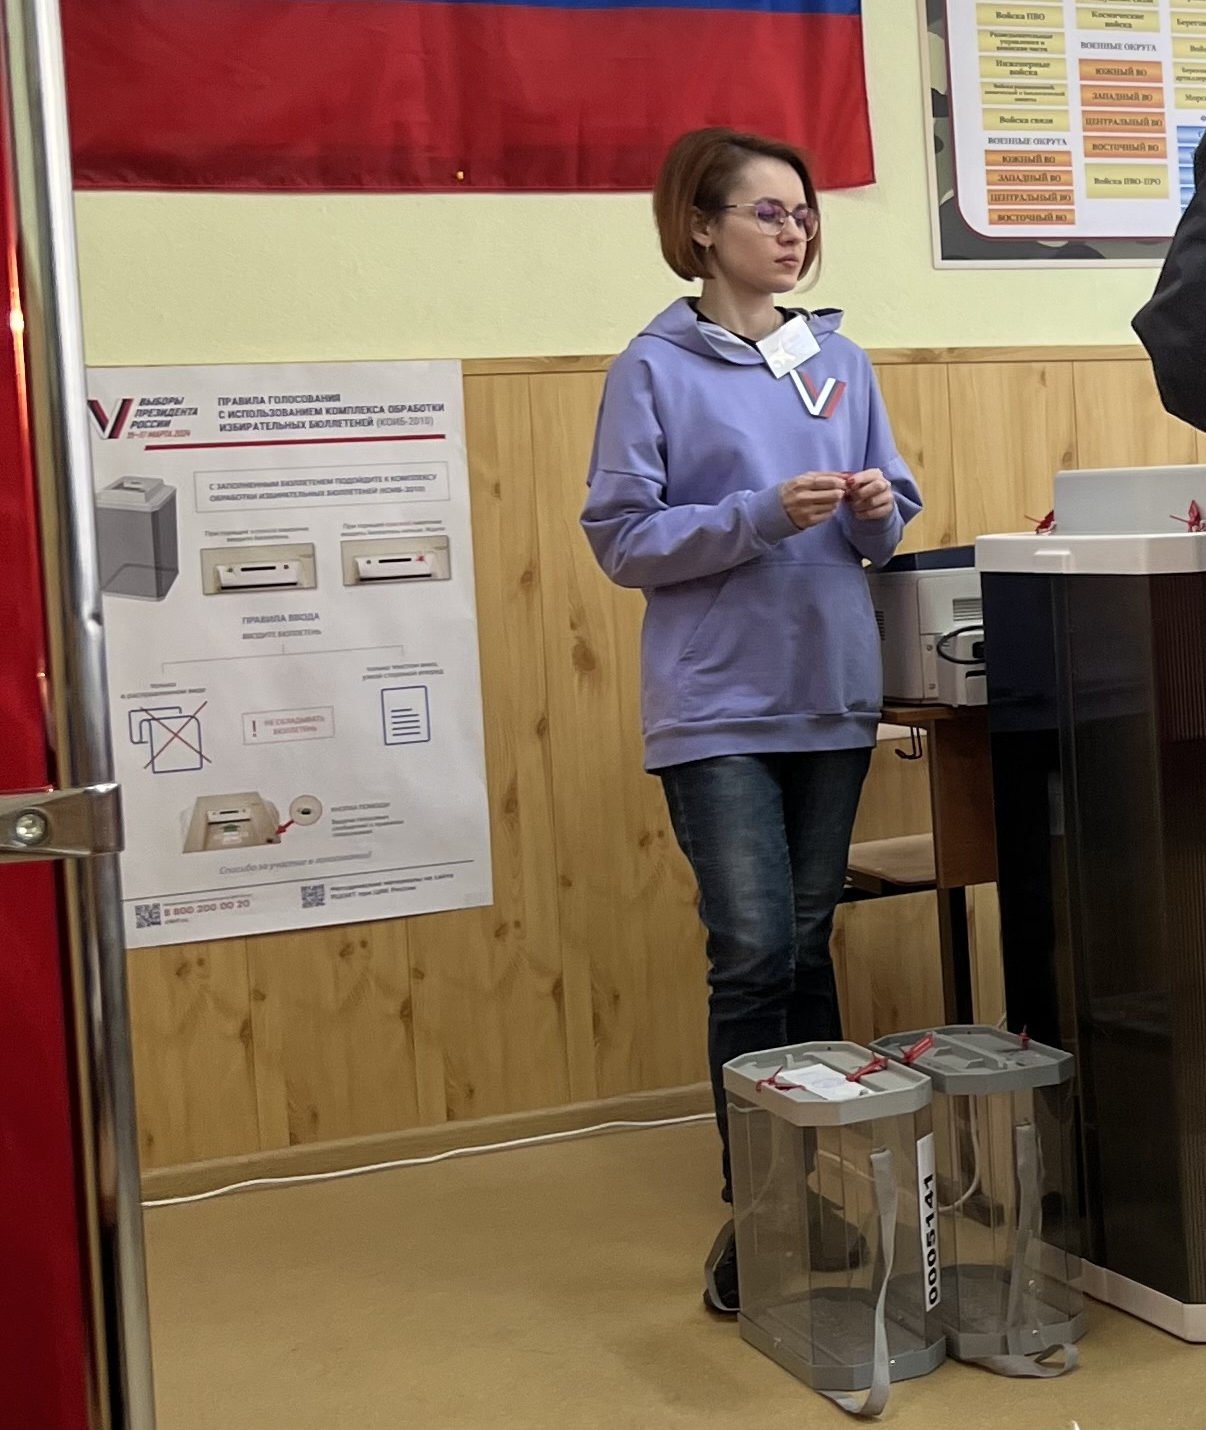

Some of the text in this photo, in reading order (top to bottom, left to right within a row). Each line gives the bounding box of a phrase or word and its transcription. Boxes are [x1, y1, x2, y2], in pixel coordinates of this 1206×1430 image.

[996, 11, 1045, 21] Войска ПВО
[1081, 42, 1156, 52] ВОЕННЫЕ ОКРУГА
[1095, 67, 1134, 76] ЮЖНЫЙ
[1092, 92, 1140, 102] ЗАПАДНЫЙ
[1000, 116, 1029, 124] Войска
[1085, 117, 1149, 127] ЦЕНТРАЛЬНЫЙ
[988, 137, 1067, 146] ВОЕННЫЕ ОКРУГА
[1092, 142, 1146, 151] ВОСТОЧНЫЙ
[1002, 154, 1042, 163] ЮЖНЫЙ
[998, 173, 1048, 183] ЗАПАДНЫЙ
[990, 192, 1058, 202] ЦЕНТРАЛЬНЫЙ
[997, 213, 1053, 222] ВОСТОЧНЫЙ
[139, 397, 184, 406] ВЫБОРЫ
[218, 394, 340, 406] ПРАВИЛА ГОЛОСОВАНИЯ
[135, 407, 198, 417] ПРЕЗИДЕНТА
[218, 403, 445, 419] С ИСПОЛЬЗОВАНИЕМ КОМПЛЕКСА ОБРАБОТКИ
[130, 419, 171, 429] РОССИИ
[219, 420, 306, 432] ИЗБИРАТЕЛЬНЫХ
[309, 416, 374, 429] БЮЛЛЕТЕНЕЙ
[242, 612, 320, 624] ПРАВИЛА ВВОДА
[924, 1173, 938, 1305] 0005141
